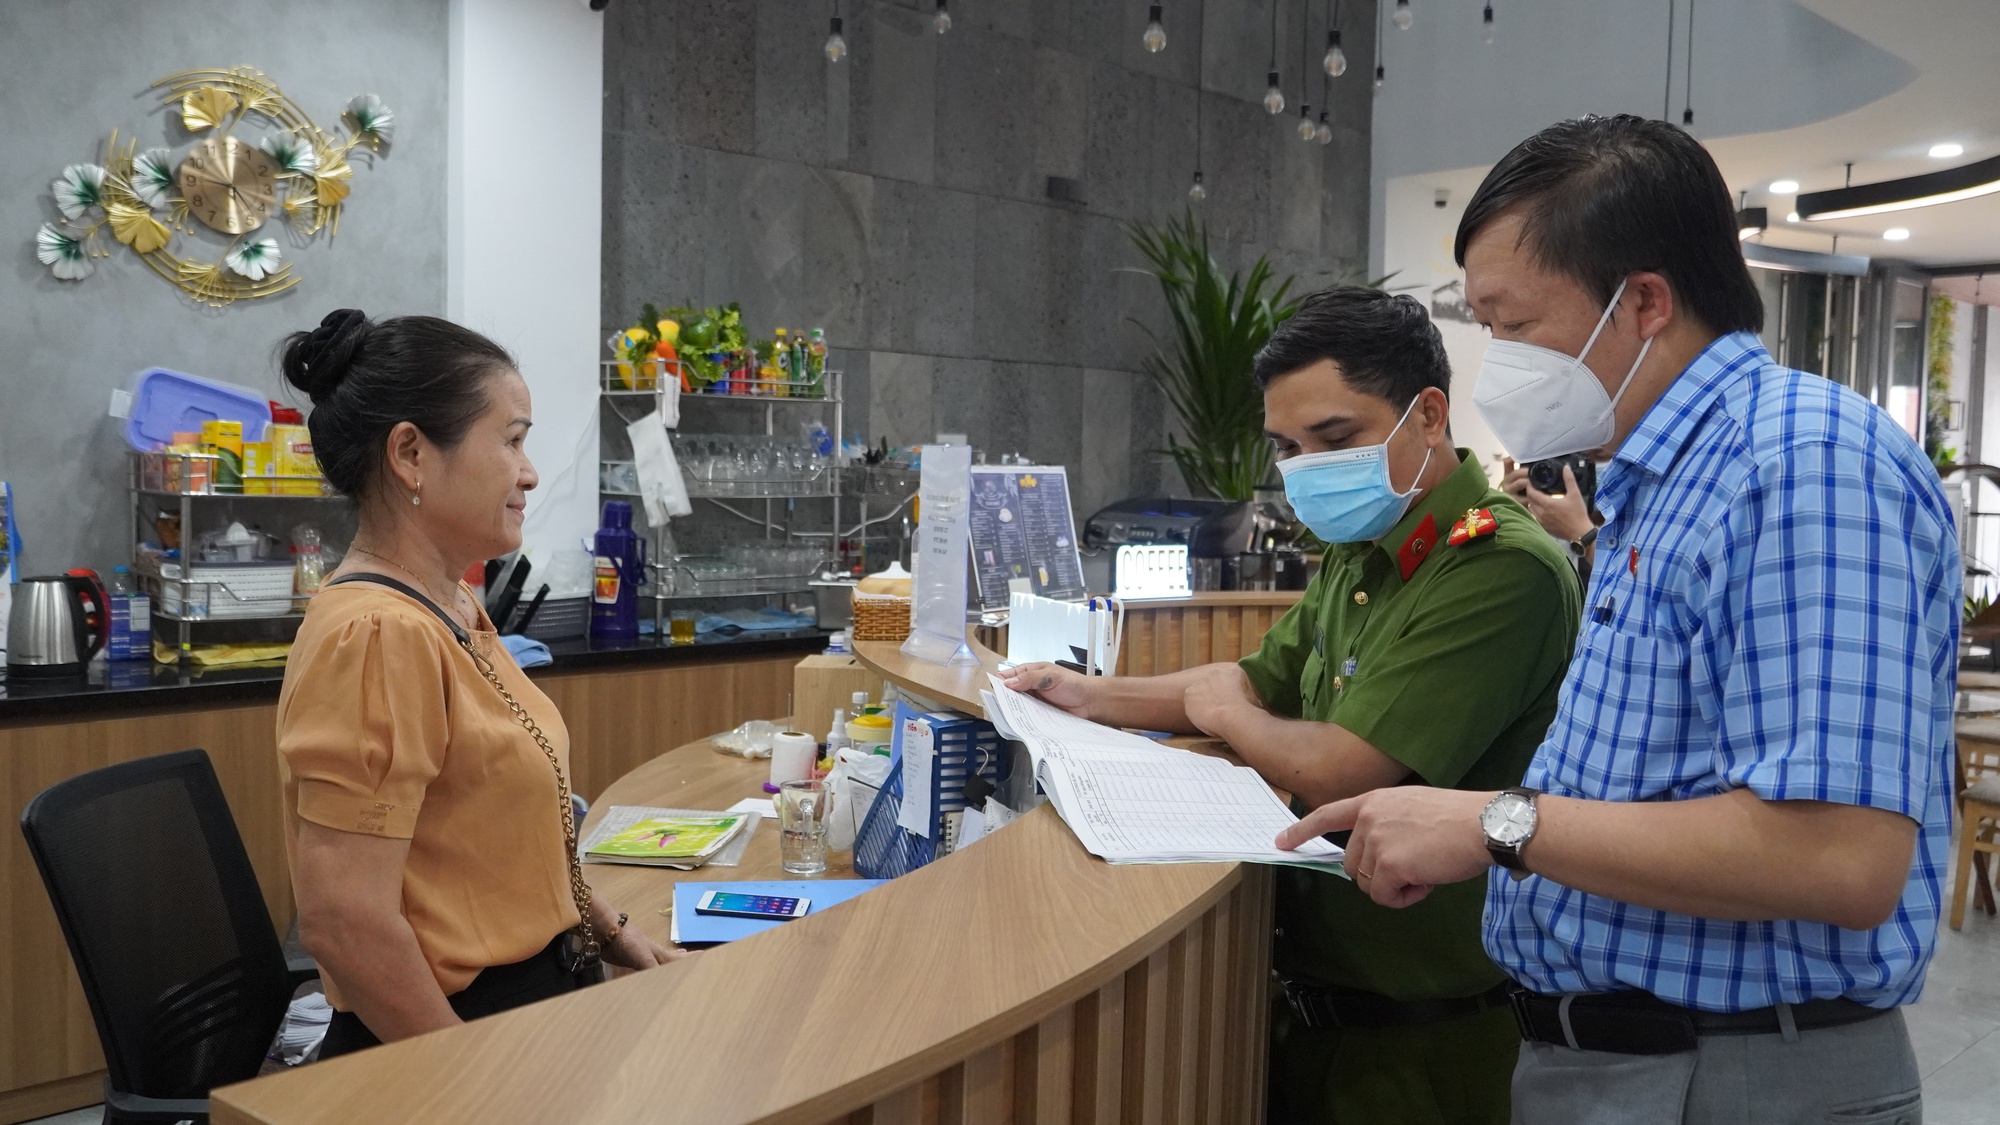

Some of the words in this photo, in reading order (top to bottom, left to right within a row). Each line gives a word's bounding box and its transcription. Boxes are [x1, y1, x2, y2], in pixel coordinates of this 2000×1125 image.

[203, 145, 216, 156] 11
[222, 142, 238, 155] 12
[245, 149, 251, 160] 1
[190, 157, 204, 169] 10
[258, 165, 268, 177] 2
[186, 175, 196, 187] 9
[263, 184, 272, 195] 3
[193, 195, 203, 207] 8
[258, 202, 266, 212] 4
[208, 210, 217, 222] 7
[245, 215, 255, 226] 5
[227, 217, 236, 228] 6
[295, 445, 313, 453] Lipto
[1117, 546, 1187, 593] COFFEE
